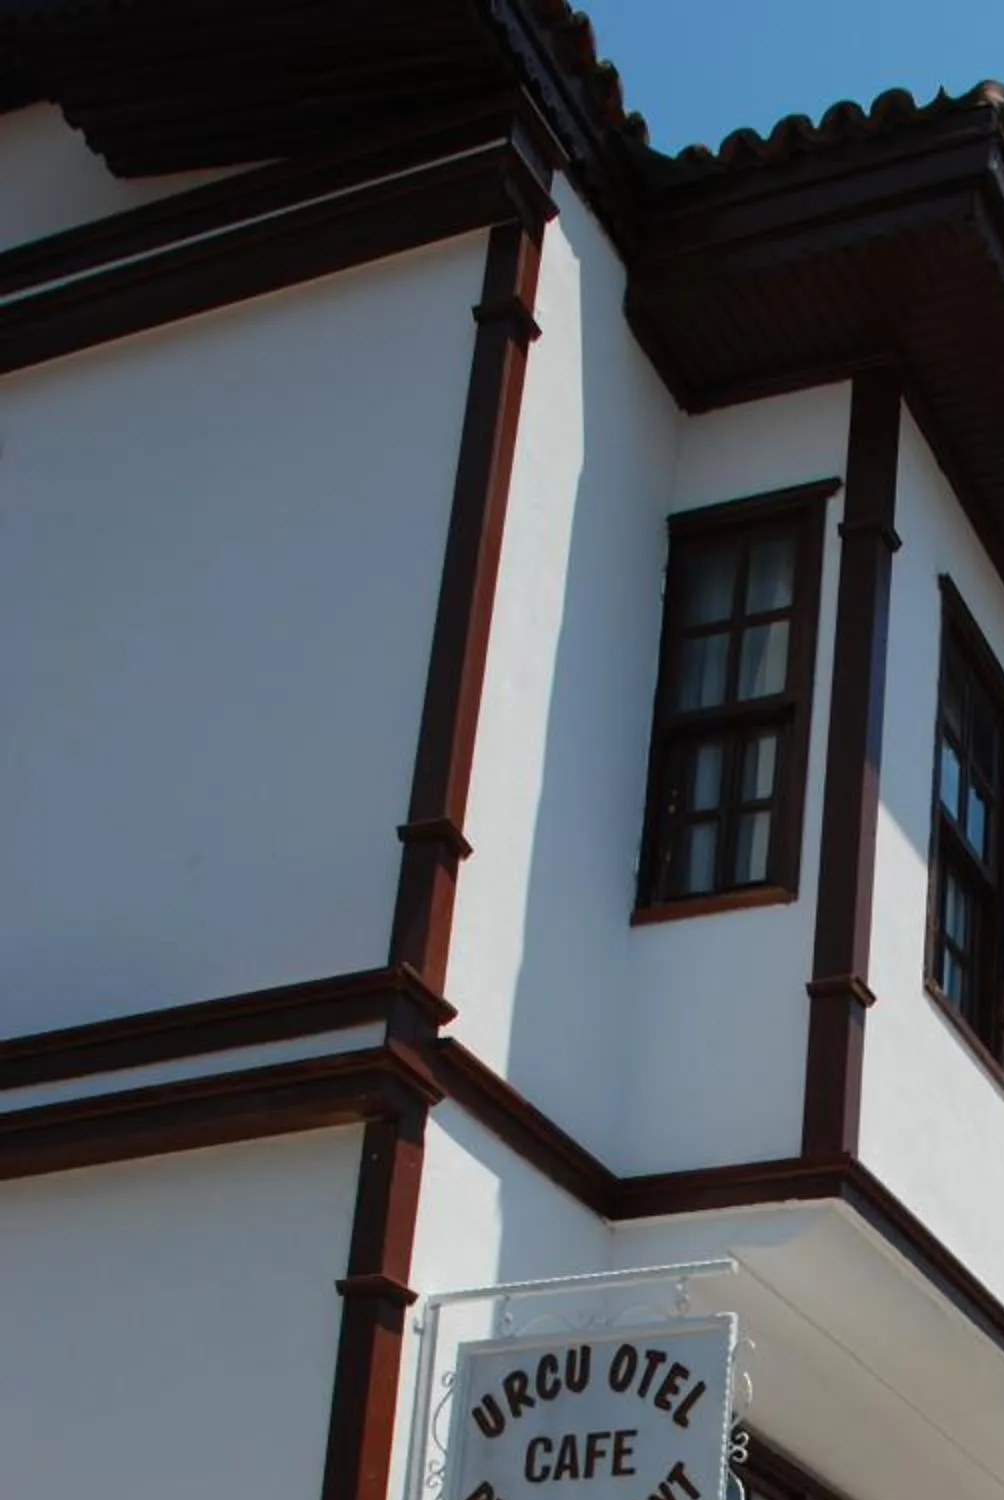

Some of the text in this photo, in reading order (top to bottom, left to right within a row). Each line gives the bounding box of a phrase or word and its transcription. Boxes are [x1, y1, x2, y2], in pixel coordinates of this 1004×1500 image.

[472, 1343, 707, 1438] URCU OTEL
[524, 1429, 638, 1483] CAFE
